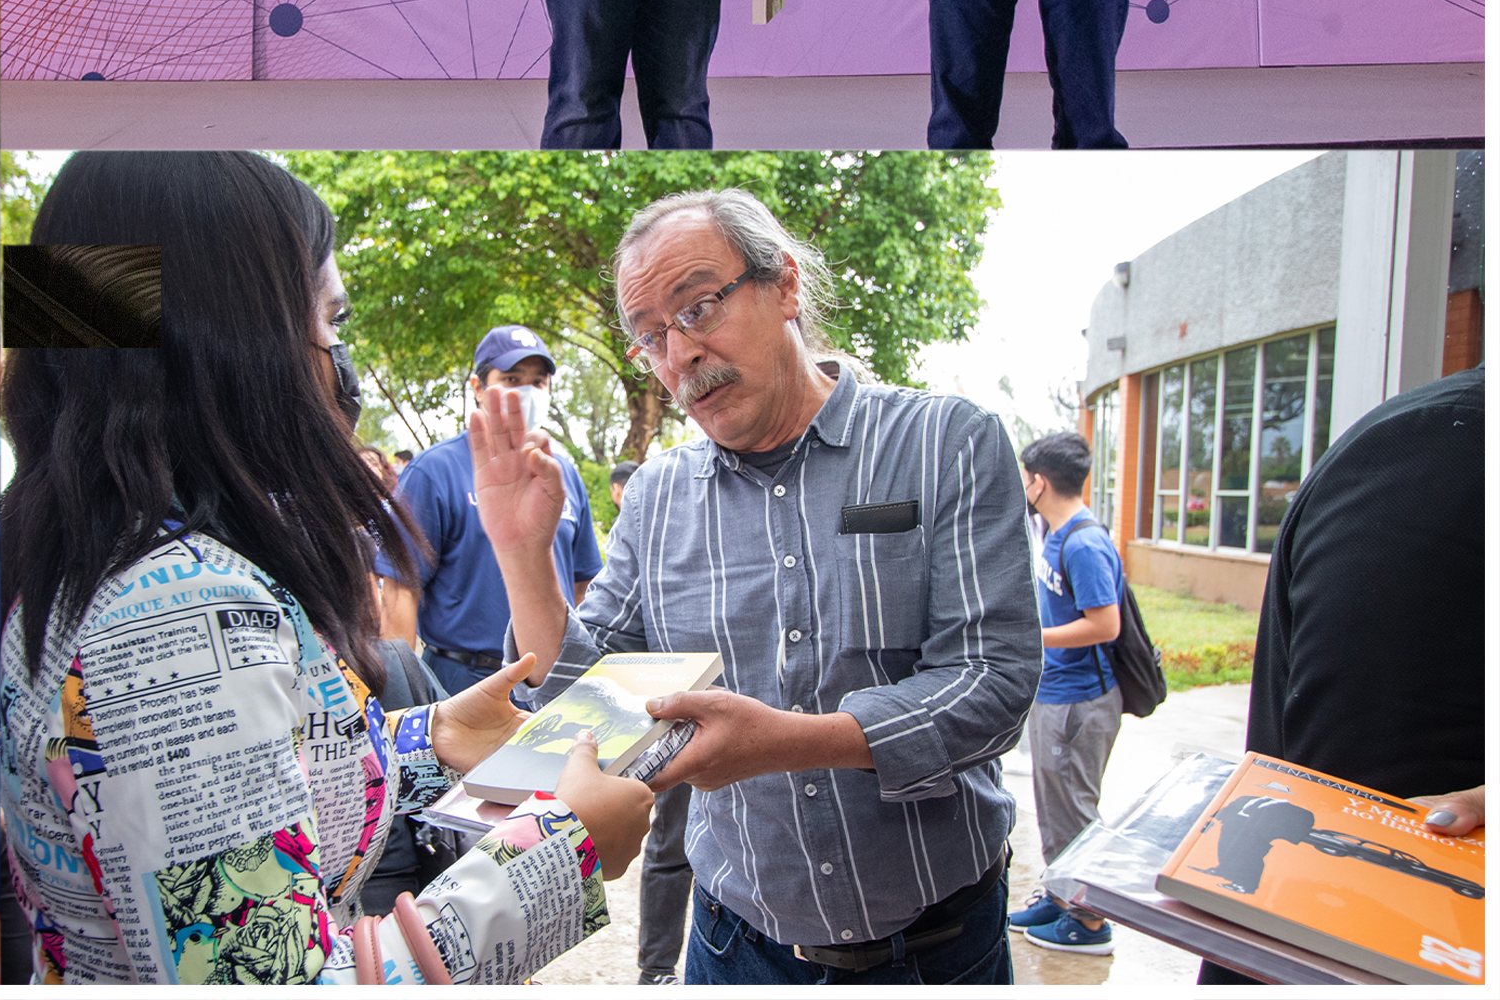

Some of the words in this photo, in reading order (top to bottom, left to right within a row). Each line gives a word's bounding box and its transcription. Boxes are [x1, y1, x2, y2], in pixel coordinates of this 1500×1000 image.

[169, 591, 193, 607] AU
[227, 611, 277, 628] DIAB
[98, 651, 134, 665] Classes
[138, 645, 154, 654] We
[156, 638, 178, 650] want
[180, 635, 196, 646] you
[198, 633, 207, 641] to
[110, 634, 155, 651] Assistant
[158, 625, 197, 639] Training
[135, 655, 154, 666] Just
[156, 650, 175, 661] click
[178, 646, 192, 655] the
[194, 642, 209, 651] link
[90, 676, 112, 687] learn
[113, 670, 141, 681] today.
[96, 704, 138, 722] bedrooms
[140, 694, 178, 710] Property
[180, 690, 197, 700] has
[199, 683, 221, 696] been
[93, 718, 136, 738] completely
[139, 705, 183, 725] renovated
[186, 702, 202, 713] and
[205, 700, 213, 709] is
[181, 715, 202, 730] Both
[203, 709, 236, 723] tenants
[102, 754, 115, 765] are
[117, 743, 150, 761] currently
[152, 740, 163, 751] on
[165, 732, 195, 747] leases
[198, 728, 214, 740] and
[217, 722, 238, 734] each
[128, 757, 153, 771] rented
[156, 754, 165, 764] at
[167, 747, 190, 763] $400
[159, 766, 175, 776] the
[180, 752, 222, 774] parsnips
[226, 750, 240, 760] are
[244, 739, 272, 755] cooked
[155, 773, 200, 789] minutes.
[201, 776, 220, 789] and
[224, 771, 241, 782] add
[245, 767, 261, 775] one
[264, 761, 278, 770] cup
[1255, 759, 1312, 781] ELENA
[1317, 777, 1384, 803] GARRO
[161, 792, 203, 811] one-half
[220, 784, 236, 795] cup
[241, 778, 250, 788] of
[162, 809, 189, 821] serve
[195, 800, 218, 812] with
[224, 794, 238, 804] the
[242, 786, 263, 800] juice
[165, 820, 189, 834] juice
[193, 814, 203, 824] of
[207, 807, 232, 820] three
[234, 795, 268, 810] oranges
[169, 821, 226, 844] teaspoonful
[231, 815, 241, 826] of
[247, 808, 263, 821] and
[1342, 805, 1375, 821] no
[165, 847, 175, 859] of
[178, 842, 205, 855] white
[249, 819, 273, 832] When
